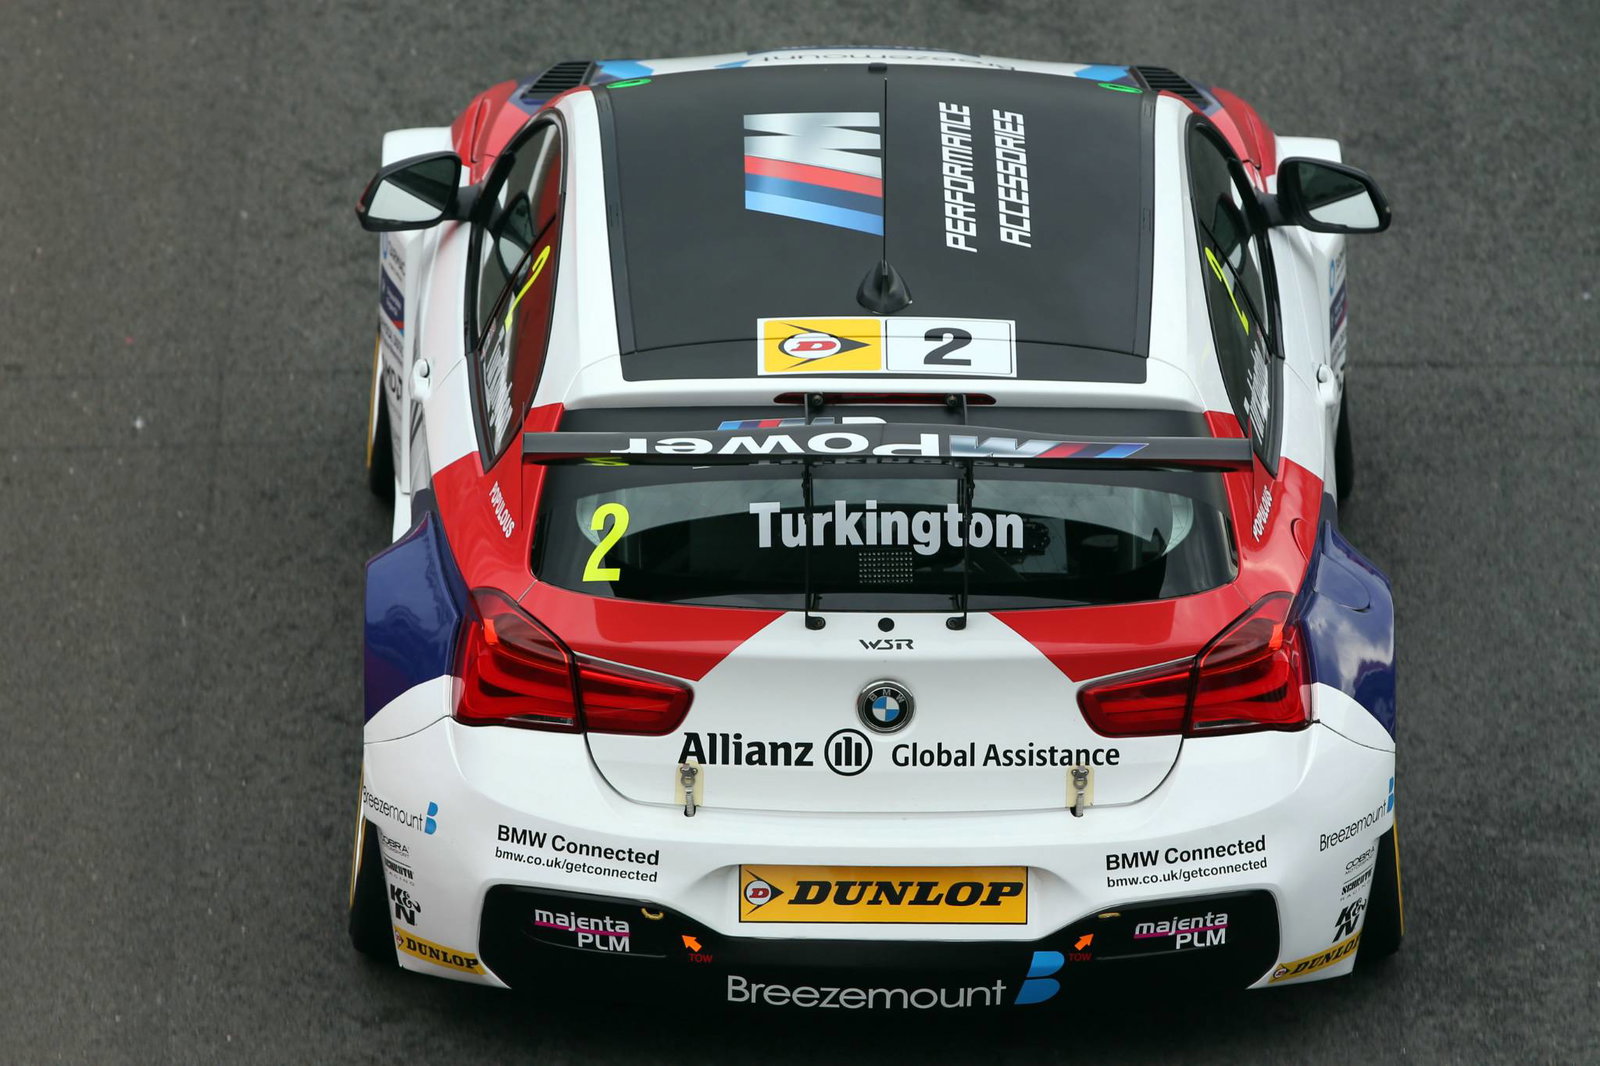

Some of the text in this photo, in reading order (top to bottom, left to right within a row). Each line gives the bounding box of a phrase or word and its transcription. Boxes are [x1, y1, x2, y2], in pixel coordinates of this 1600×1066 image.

[939, 102, 977, 253] PERFORMANCE
[993, 109, 1031, 248] ACCESSORIES
[923, 327, 973, 366] 2
[489, 481, 515, 538] POPULOUS
[582, 502, 630, 582] 2
[750, 500, 1024, 556] Turkington
[859, 638, 914, 650] WSR
[869, 689, 905, 703] BMW
[678, 732, 1120, 767] Allianz Global Assistance
[1319, 799, 1386, 852] Breezemount
[497, 824, 660, 866] BMW Connected
[1106, 835, 1266, 871] BMW Connected
[494, 846, 658, 883] bmw.co.uk/getconnected
[1107, 857, 1268, 888] bmw.co.uk/getconnected
[787, 880, 1023, 907] DUNLOP
[535, 909, 630, 933] majenta
[1134, 911, 1228, 935] majenta
[406, 937, 479, 969] DUNLOP
[577, 932, 630, 952] PLM
[1175, 928, 1226, 950] PLM
[688, 953, 713, 963] TOW
[1069, 952, 1092, 962] TOW
[727, 975, 1007, 1009] Breezemount
